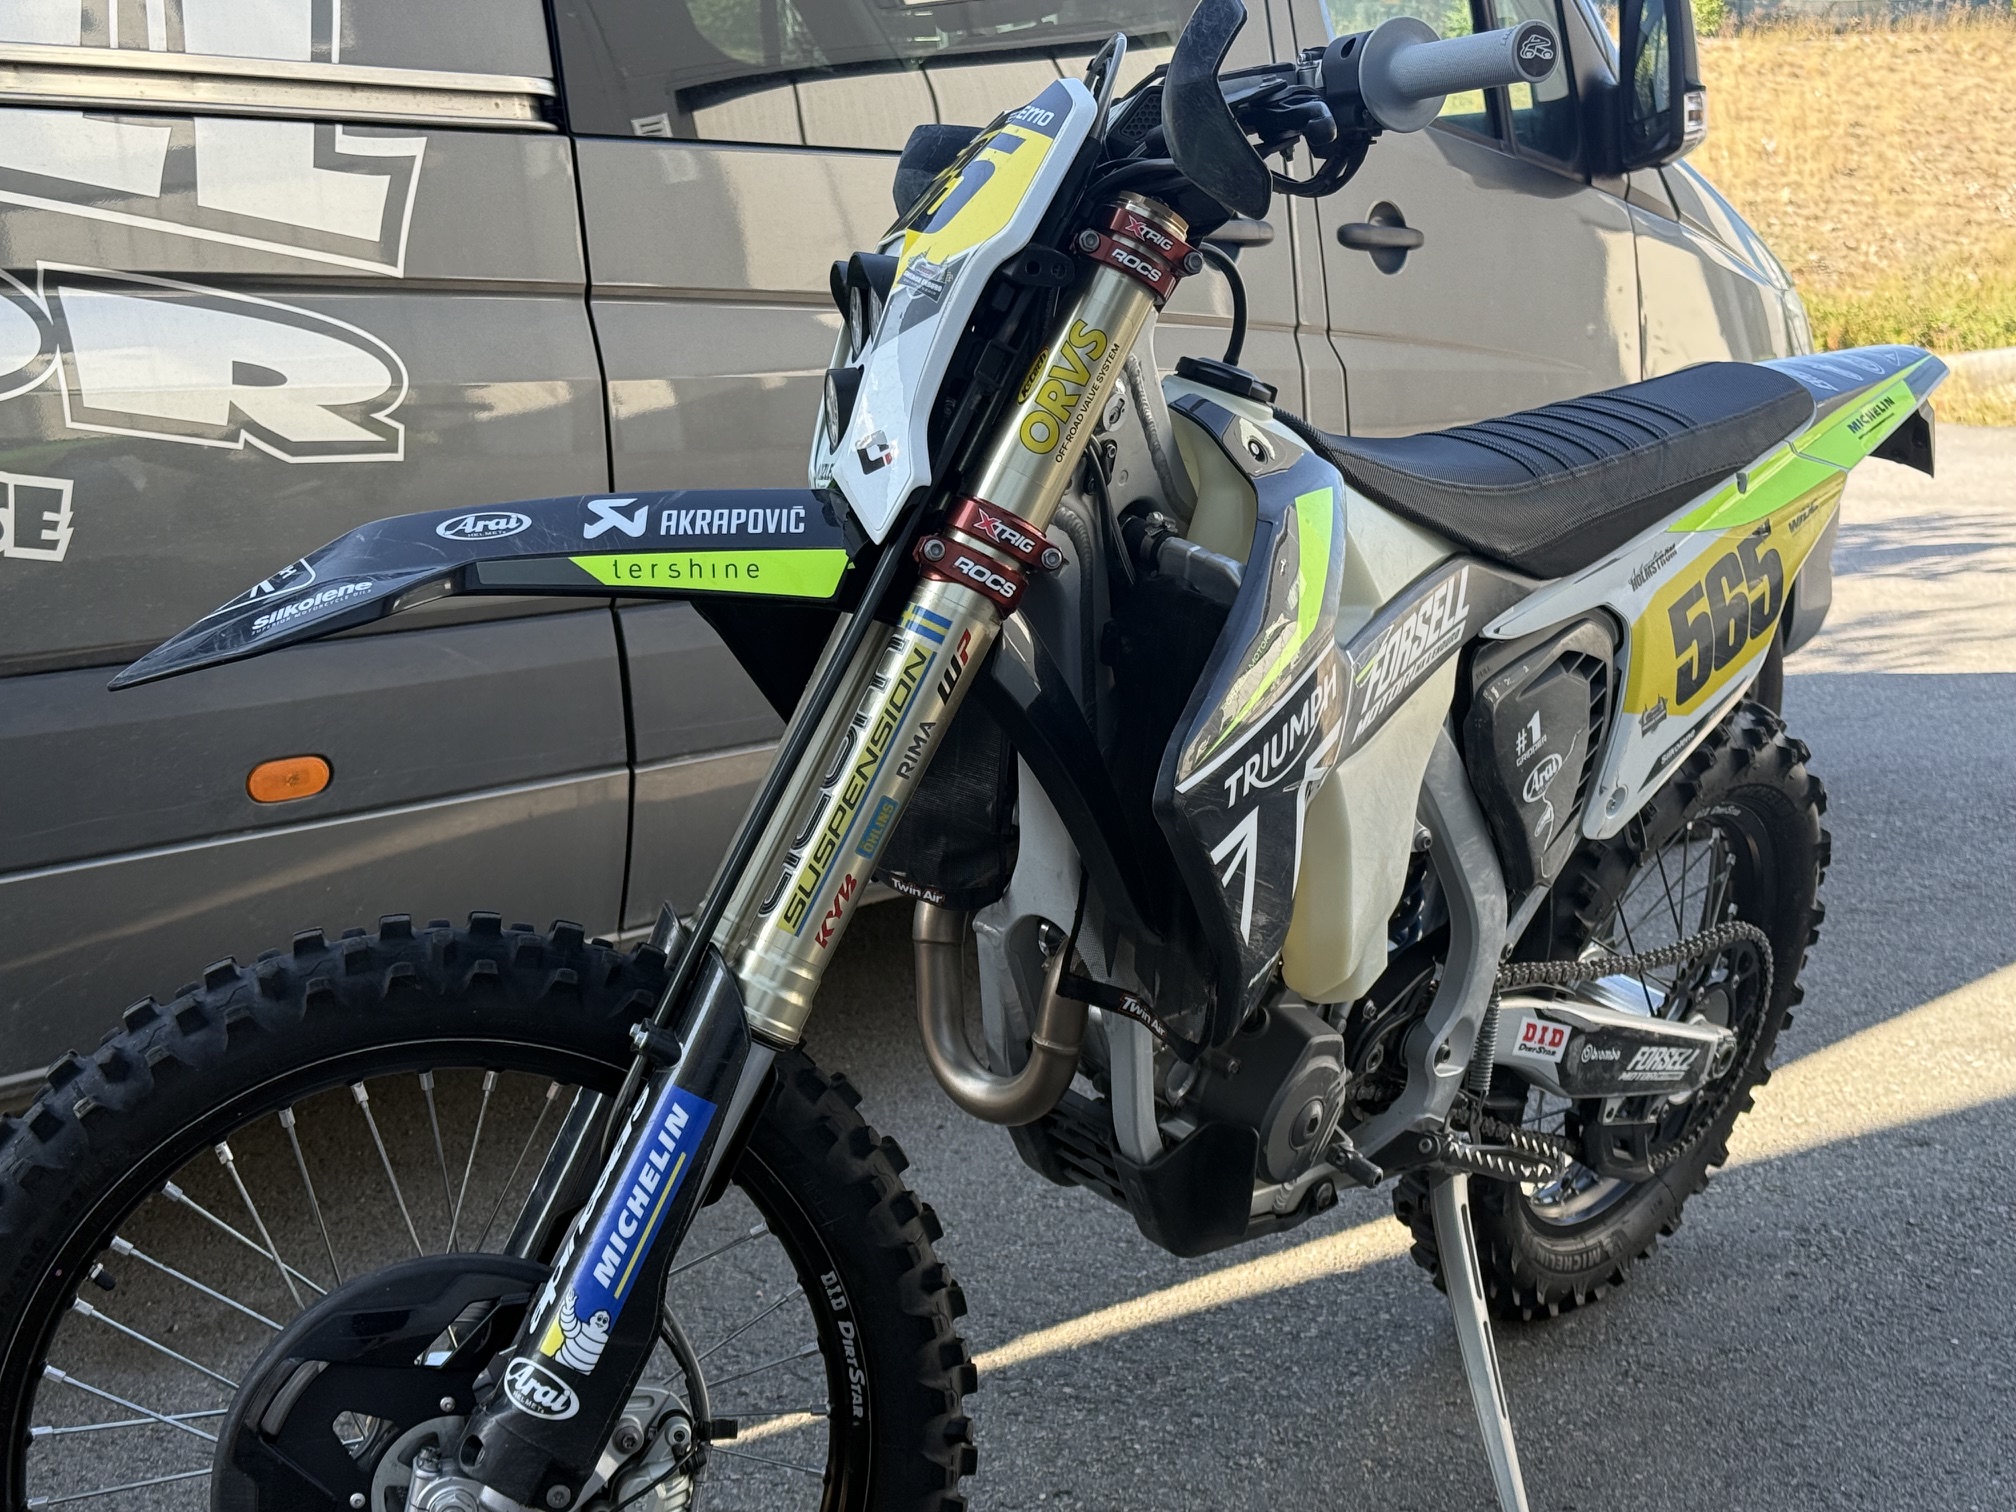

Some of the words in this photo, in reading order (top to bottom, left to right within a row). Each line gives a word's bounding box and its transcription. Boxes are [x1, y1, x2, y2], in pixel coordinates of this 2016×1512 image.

[1125, 215, 1174, 251] XTRIG
[1111, 248, 1161, 282] ROCS
[1020, 319, 1107, 454] ORVS
[1055, 413, 1083, 463] OFF-ROAD
[1082, 383, 1100, 416] VALVE
[1097, 343, 1120, 384] SYSTEM
[1847, 396, 1896, 434] MICHELIN
[446, 513, 520, 535] Arai
[974, 507, 1036, 554] XTRIG
[612, 557, 760, 579] tershine
[953, 556, 1017, 598] ROCS
[252, 580, 373, 630] Silkolene
[1668, 521, 1784, 706] 565
[1361, 565, 1469, 715] FORSELL
[937, 628, 972, 706] WP
[896, 720, 937, 781] RIMA
[1224, 663, 1336, 808] TRIUMPH
[1516, 710, 1541, 756] #1
[783, 647, 927, 930] SUSPENSION
[814, 873, 857, 949] KYB
[891, 878, 920, 897] Twin
[923, 890, 943, 903] Air
[1122, 995, 1150, 1023] Twin
[1150, 1019, 1166, 1037] Air
[1522, 1022, 1564, 1048] D.I.D
[1626, 1046, 1699, 1071] FORSELL
[591, 1101, 690, 1290] MICHELIN
[1537, 1245, 1602, 1272] MICHELIN
[506, 1364, 571, 1412] Arai
